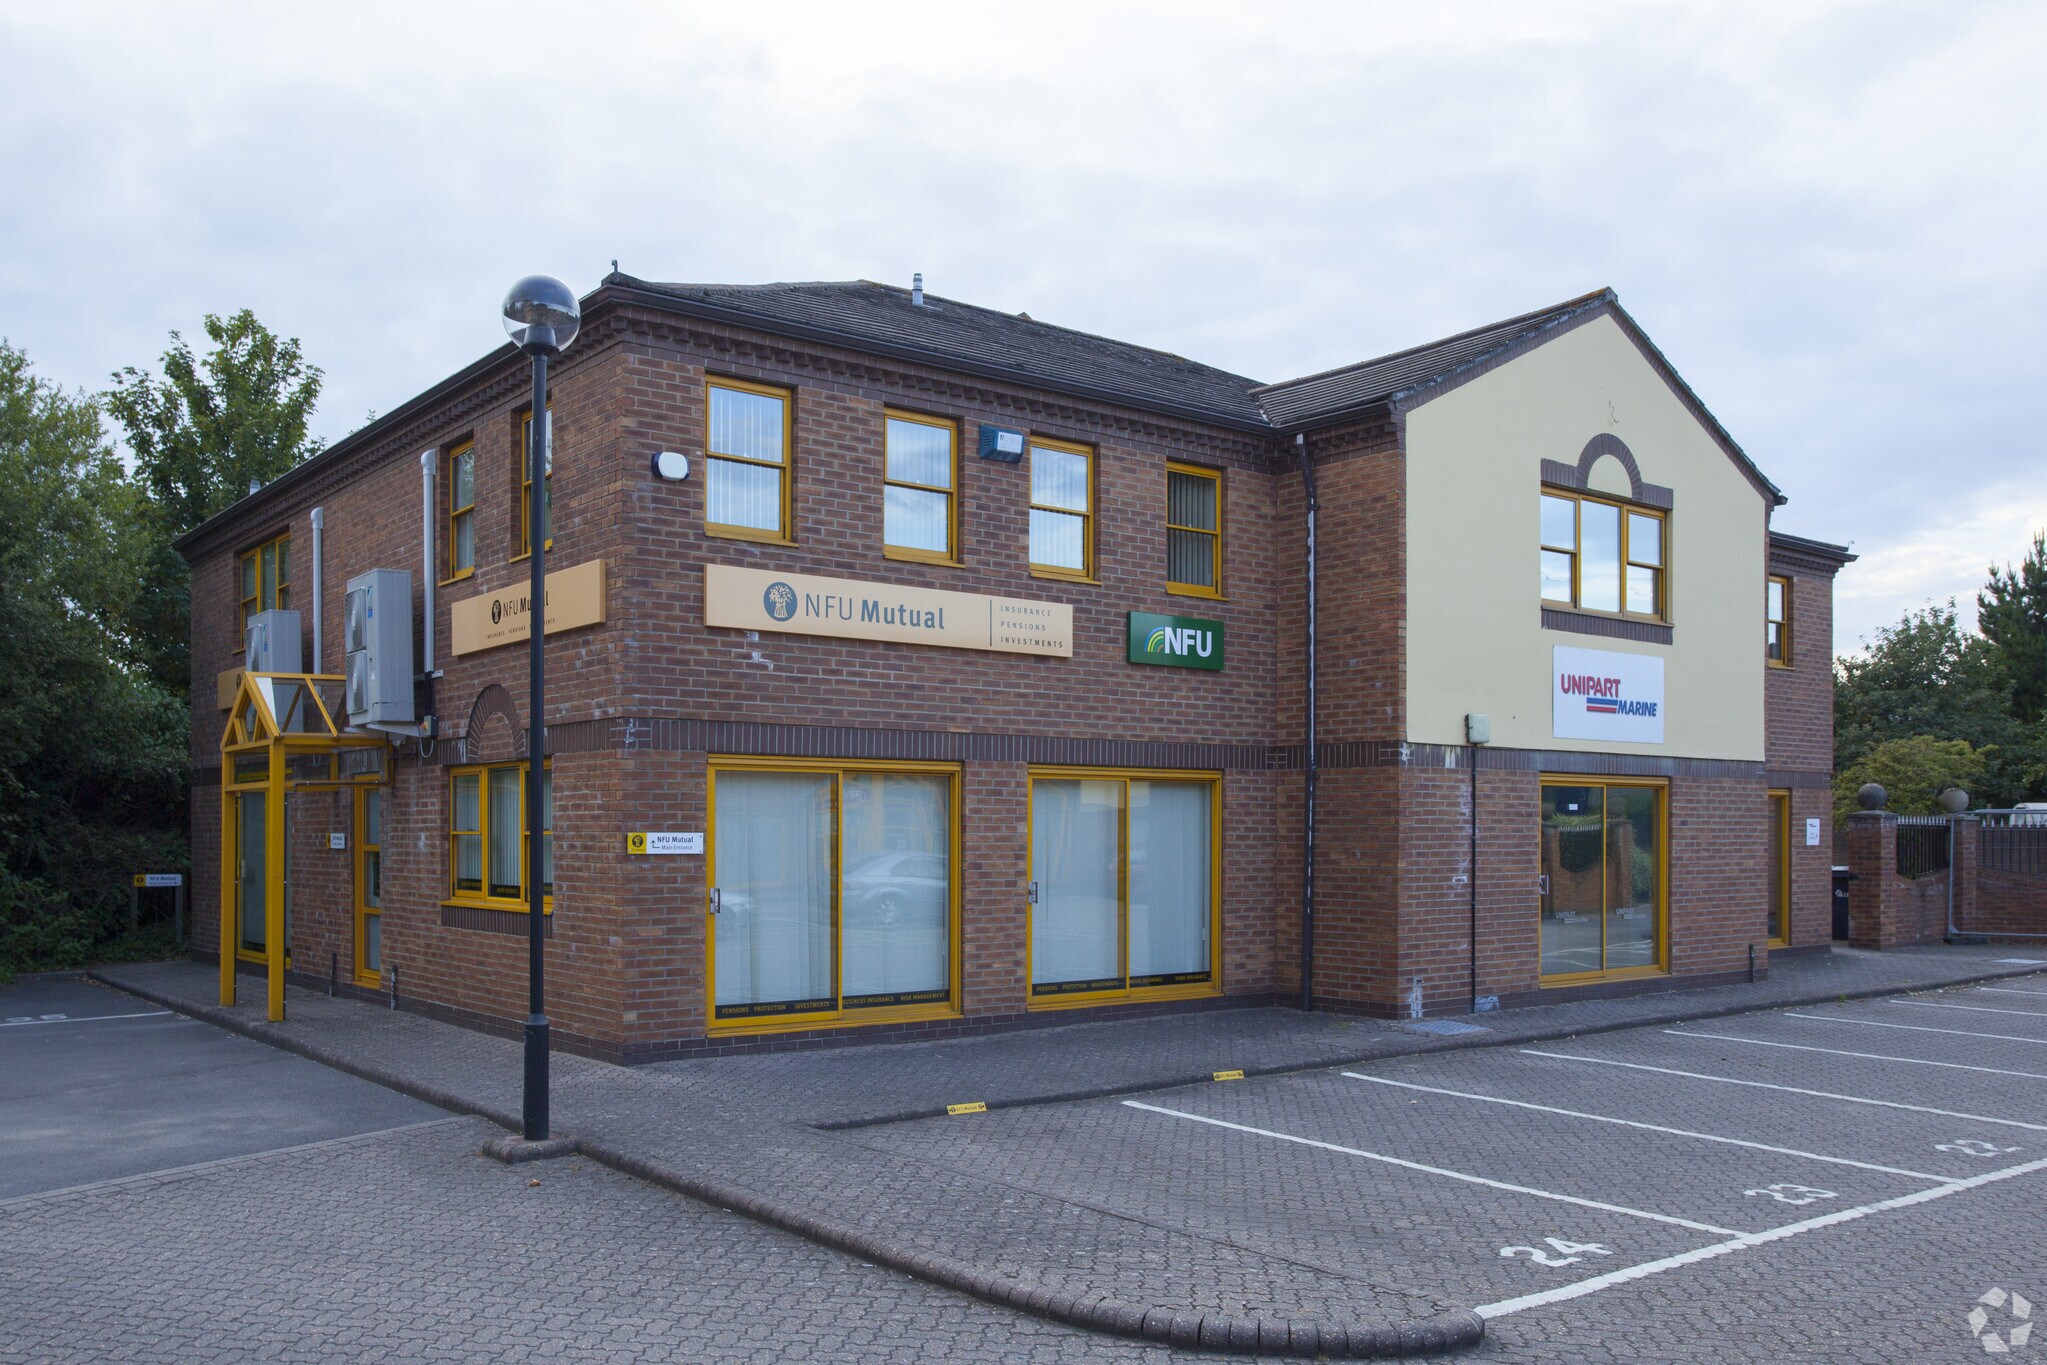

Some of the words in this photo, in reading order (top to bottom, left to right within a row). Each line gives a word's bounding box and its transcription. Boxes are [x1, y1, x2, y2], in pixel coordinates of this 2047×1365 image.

[502, 599, 519, 618] NFU
[520, 590, 549, 614] Mul
[805, 593, 853, 621] NFU
[860, 599, 945, 630] Mutual
[1000, 605, 1051, 617] INSURANCE
[1000, 620, 1046, 632] PENSIONS
[1000, 636, 1064, 648] INVESTMENTS
[1164, 626, 1212, 658] NFU
[1560, 673, 1621, 698] UNIPART
[1617, 700, 1658, 717] MARINE
[913, 992, 945, 1000] MANAGEMENT
[721, 1006, 749, 1014] PENSIONS
[754, 1004, 786, 1012] PROTECTION
[1933, 1139, 2023, 1158] 22
[1742, 1183, 1839, 1205] 23
[1499, 1236, 1614, 1268] 24
